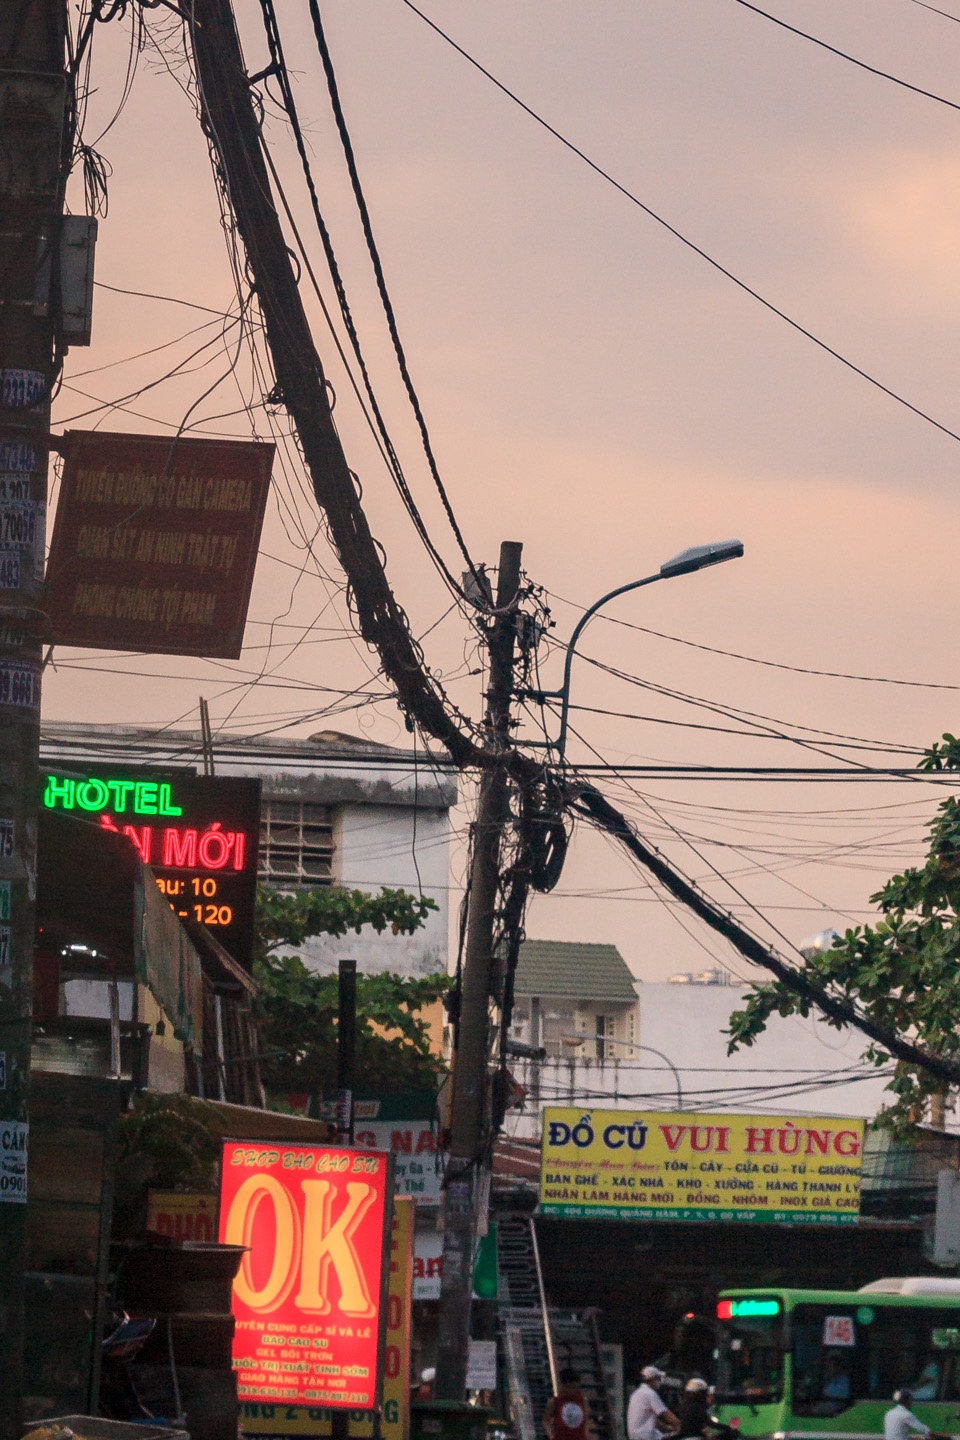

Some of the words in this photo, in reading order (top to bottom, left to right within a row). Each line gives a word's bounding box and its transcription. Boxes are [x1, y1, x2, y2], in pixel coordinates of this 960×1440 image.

[202, 477, 254, 512] CAMERA
[76, 524, 110, 558] QUAN
[135, 529, 155, 561] AN
[154, 530, 186, 564] NINH
[44, 776, 182, 817] HOTEL
[164, 822, 245, 870] MỚI
[548, 1114, 595, 1148] ĐỒ
[602, 1120, 649, 1150] CŨ
[657, 1124, 732, 1154] VUI
[744, 1121, 862, 1157] HÙNG
[231, 1150, 280, 1168] SHOP
[281, 1152, 315, 1170] BAO
[315, 1154, 349, 1174] CAO
[350, 1156, 380, 1174] SU
[611, 1175, 636, 1188] XÁC
[640, 1177, 665, 1188] NHÀ
[677, 1178, 703, 1189] KHO
[765, 1179, 799, 1192] HÀNG
[803, 1181, 842, 1193] THANH
[780, 1196, 808, 1207] INOX
[835, 1198, 860, 1209] CAO
[222, 1173, 377, 1319] OK
[267, 1322, 298, 1334] CUNG
[299, 1323, 323, 1335] CẤP
[338, 1326, 354, 1337] VÀ
[262, 1335, 286, 1347] BAO
[287, 1337, 311, 1348] CAO
[312, 1338, 329, 1349] SU
[256, 1348, 276, 1358] GEL
[280, 1349, 301, 1360] BÔI
[240, 1372, 267, 1383] GIAO
[268, 1373, 300, 1385] HÀNG
[314, 1364, 341, 1376] TINH
